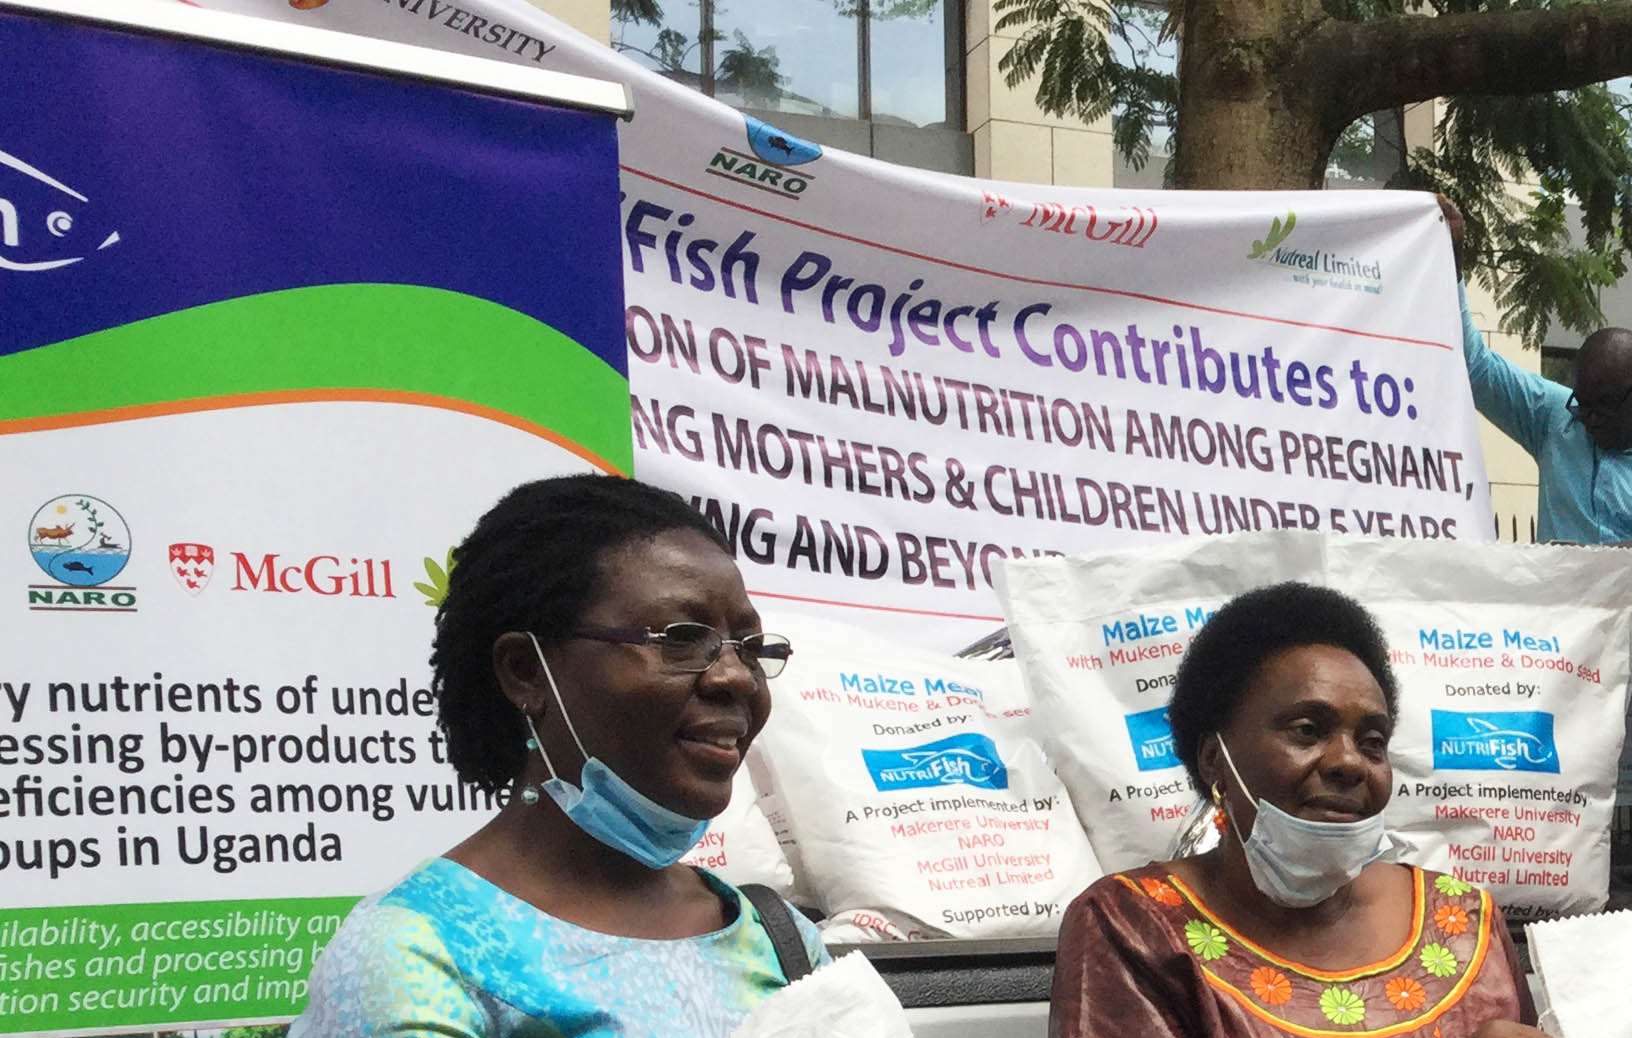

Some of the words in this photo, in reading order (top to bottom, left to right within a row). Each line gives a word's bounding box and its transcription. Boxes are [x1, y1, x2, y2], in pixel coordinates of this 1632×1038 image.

[710, 152, 808, 195] NARO
[1270, 247, 1320, 271] Nutreal
[1324, 254, 1381, 280] Limited
[616, 192, 761, 305] Fish
[781, 251, 1000, 357] Project
[1013, 303, 1338, 409] Contributes
[1350, 360, 1418, 420] to:
[626, 305, 701, 374] ON
[709, 327, 772, 388] OF
[781, 344, 1115, 453] MALNUTRITION
[1126, 411, 1273, 472] AMONG
[1282, 430, 1473, 501] PREGNANT,
[630, 394, 704, 462] NG
[712, 412, 935, 504] MOTHERS
[945, 458, 977, 511] &
[983, 464, 1189, 535] CHILDREN
[787, 514, 888, 580] AND
[231, 552, 397, 599] McGill
[29, 590, 136, 607] NARO
[1503, 628, 1561, 653] Meal
[48, 672, 262, 714] nutrients
[276, 675, 317, 714] of
[1445, 682, 1511, 697] Donated
[160, 722, 417, 773] by-products
[250, 782, 395, 822] among
[864, 799, 926, 819] Project
[1415, 783, 1473, 799] Project
[1479, 783, 1572, 804] implemented
[1435, 805, 1510, 819] Makerere
[118, 826, 160, 866] in
[177, 822, 342, 874] Uganda
[1493, 826, 1536, 842] NARO
[1448, 844, 1496, 862] McGill
[130, 911, 300, 943] accessibility
[942, 901, 1029, 924] Supported
[85, 950, 145, 977] and
[153, 944, 303, 980] processing
[68, 981, 188, 1013] security
[193, 976, 249, 1004] and
[257, 978, 310, 1005] imp
